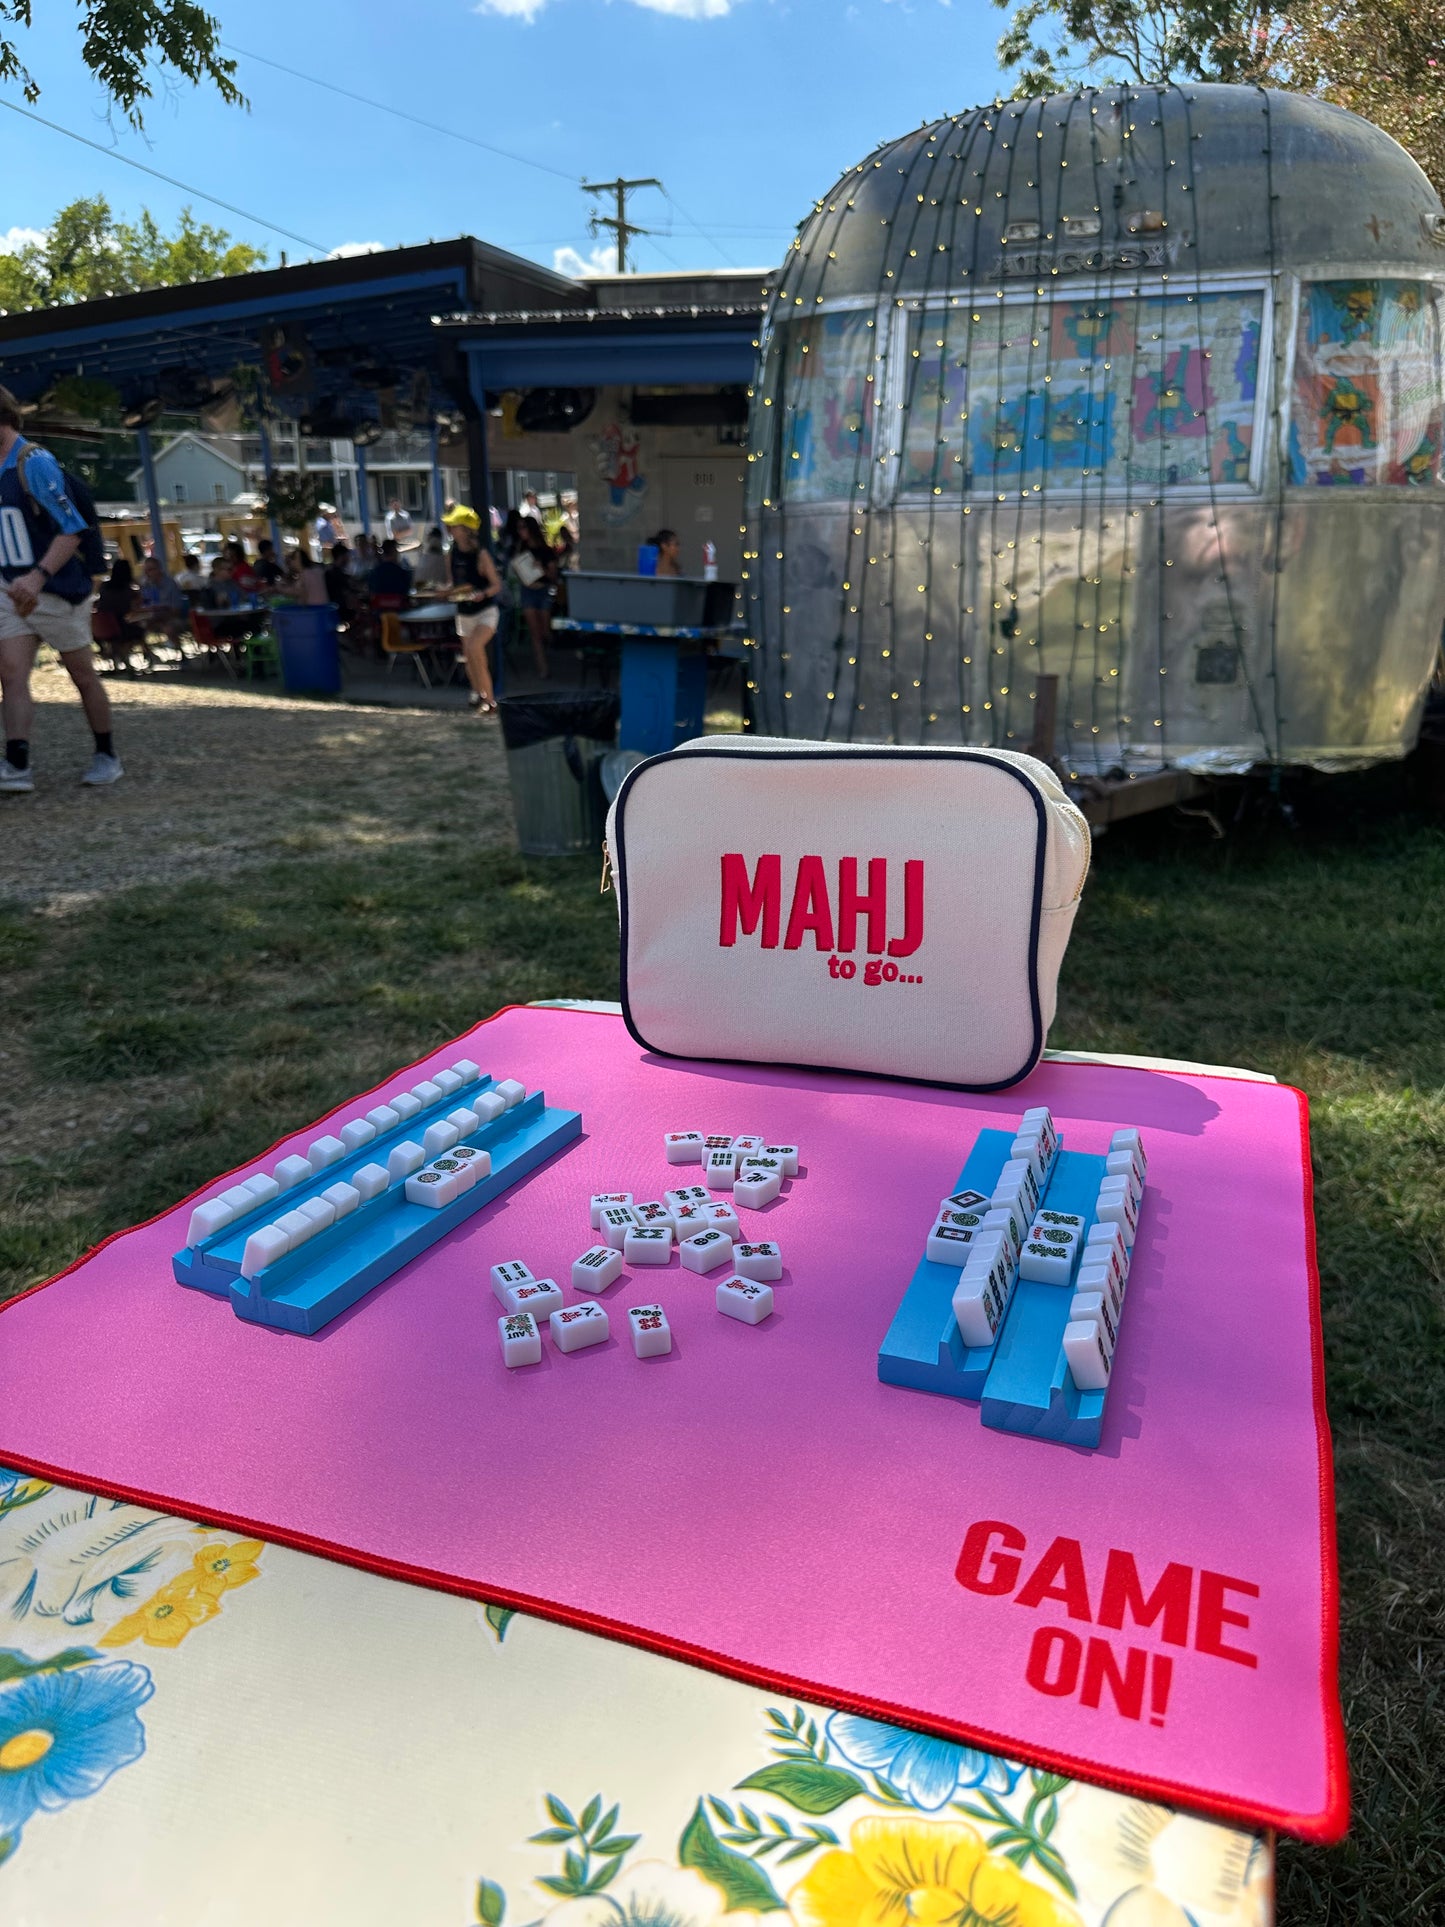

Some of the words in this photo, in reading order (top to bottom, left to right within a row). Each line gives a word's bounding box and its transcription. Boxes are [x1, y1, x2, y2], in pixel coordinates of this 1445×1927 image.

[988, 241, 1167, 279] ARGOSY
[719, 853, 924, 958] MAHJ
[827, 954, 857, 980] to
[863, 959, 923, 986] go...
[954, 1519, 1260, 1670] GAME
[1025, 1626, 1174, 1728] ON!
